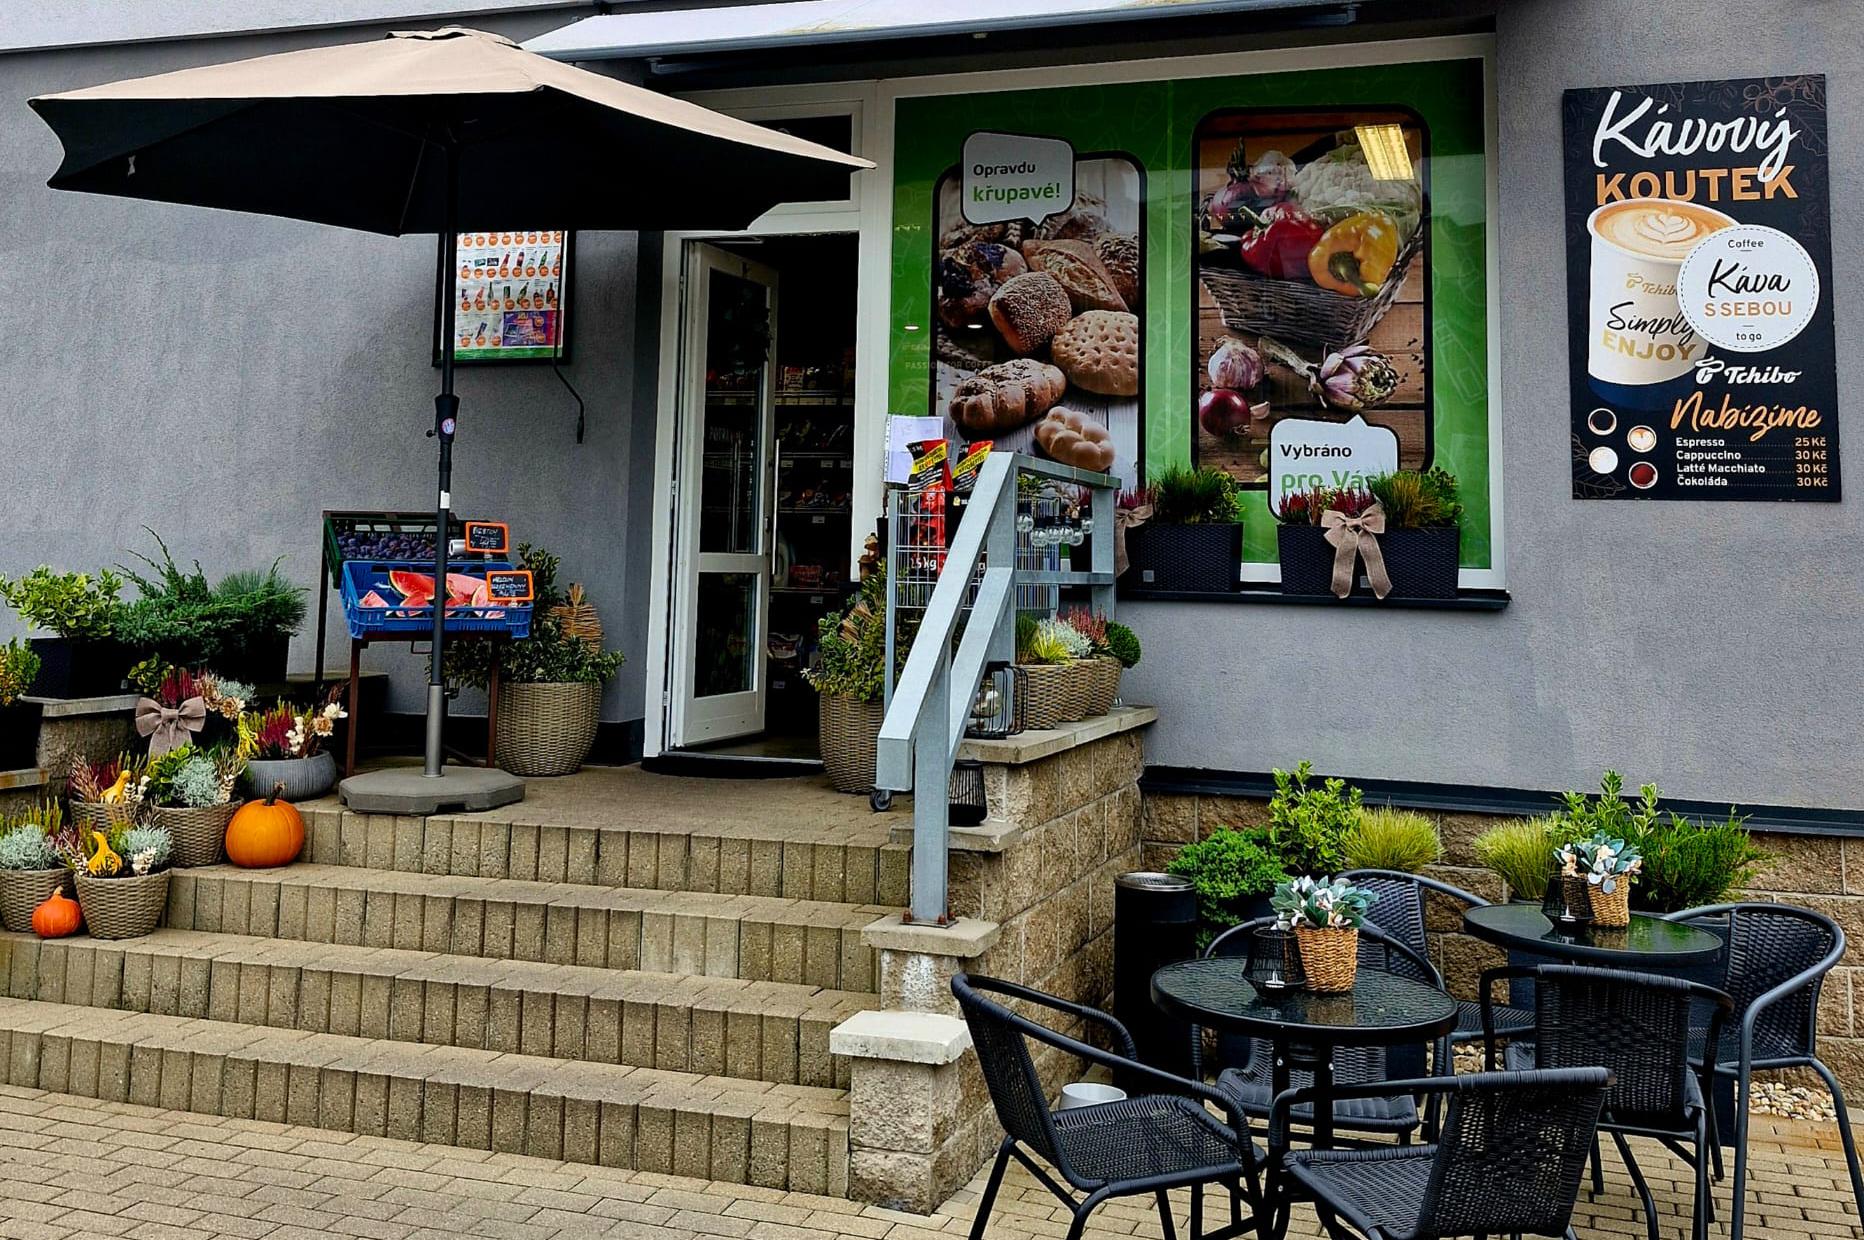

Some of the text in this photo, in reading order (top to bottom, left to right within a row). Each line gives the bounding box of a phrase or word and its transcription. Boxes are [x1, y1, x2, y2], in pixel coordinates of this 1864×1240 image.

[1593, 91, 1802, 182] Kávový
[973, 161, 1036, 178] Opravdu
[973, 183, 1060, 204] křupavé!
[1596, 165, 1798, 206] KOUTEK
[1728, 239, 1765, 249] Coffee
[1707, 258, 1791, 298] Káva
[1720, 301, 1792, 316] SEBOU
[1606, 301, 1695, 346] Simply
[1603, 329, 1697, 361] ENJOY
[1736, 332, 1762, 343] to go
[1724, 366, 1802, 384] Tchibo
[1671, 391, 1822, 442] Nabízíme
[1676, 437, 1827, 449] Espresso 25 Kč
[1280, 444, 1352, 460] Vybráno
[1676, 450, 1827, 462] Cappuccino 30 Kč
[1677, 463, 1828, 473] Latté Macchiato 30 Kč
[1281, 473, 1323, 492] pro
[1677, 475, 1828, 487] Čokoláda 30 Kč
